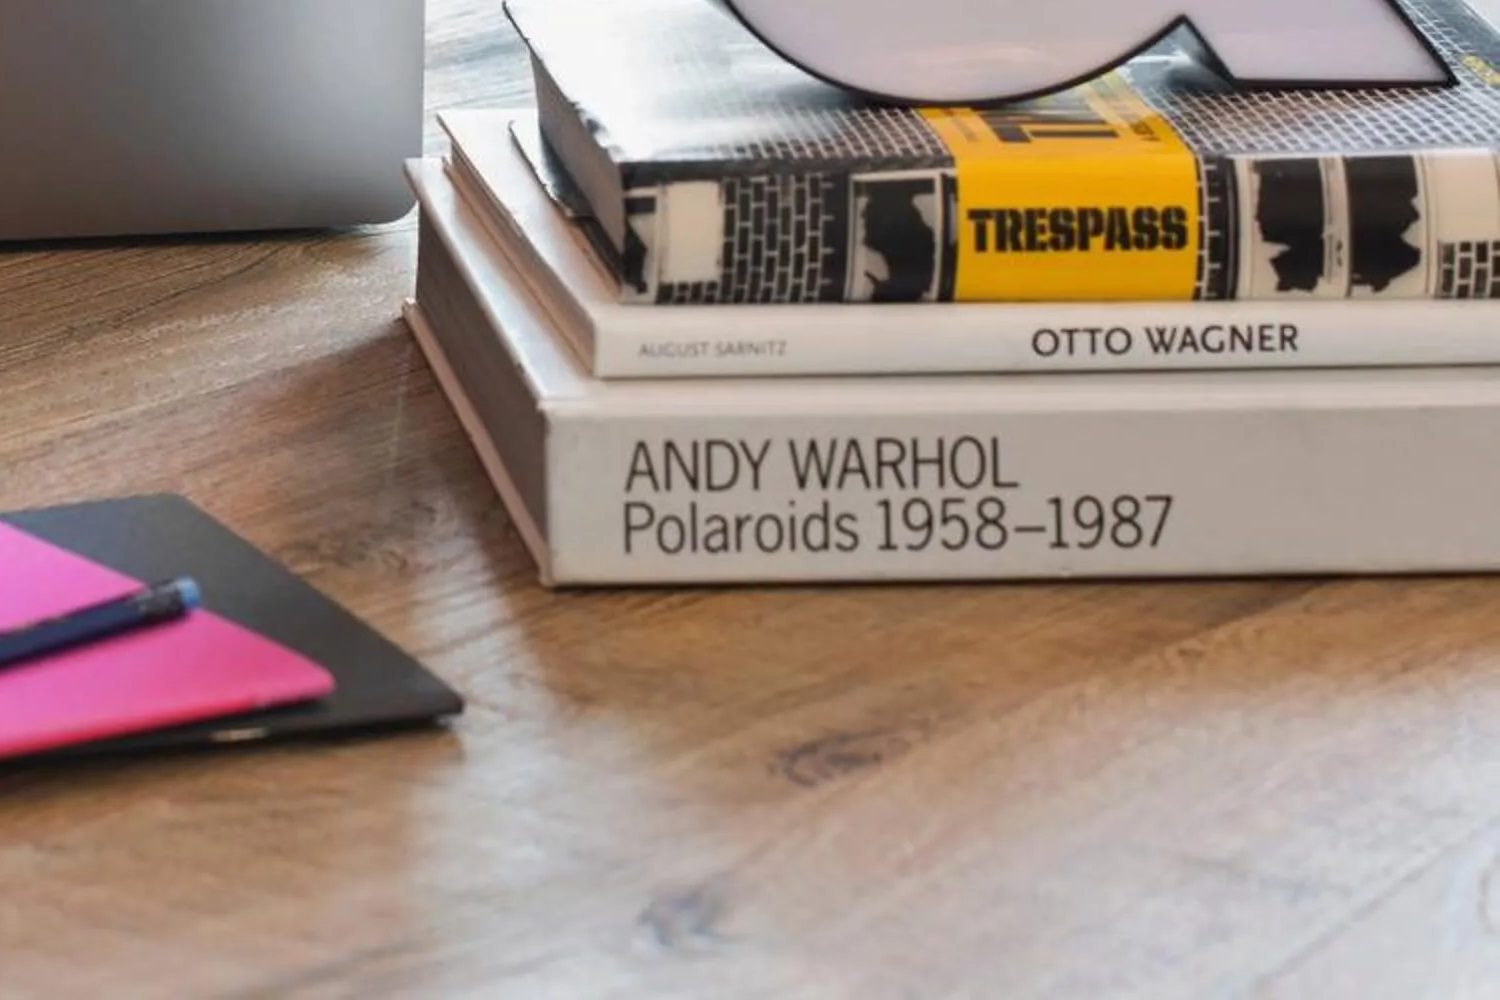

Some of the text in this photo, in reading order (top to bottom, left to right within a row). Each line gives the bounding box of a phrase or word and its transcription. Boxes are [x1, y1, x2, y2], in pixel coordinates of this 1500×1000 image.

[967, 206, 1189, 252] TRESPASS
[638, 341, 787, 359] AUGUST SARNITZ
[1031, 324, 1299, 356] OTTO WAGNER
[624, 436, 1020, 492] ANDY WARHOL
[624, 500, 860, 554] Polaroids
